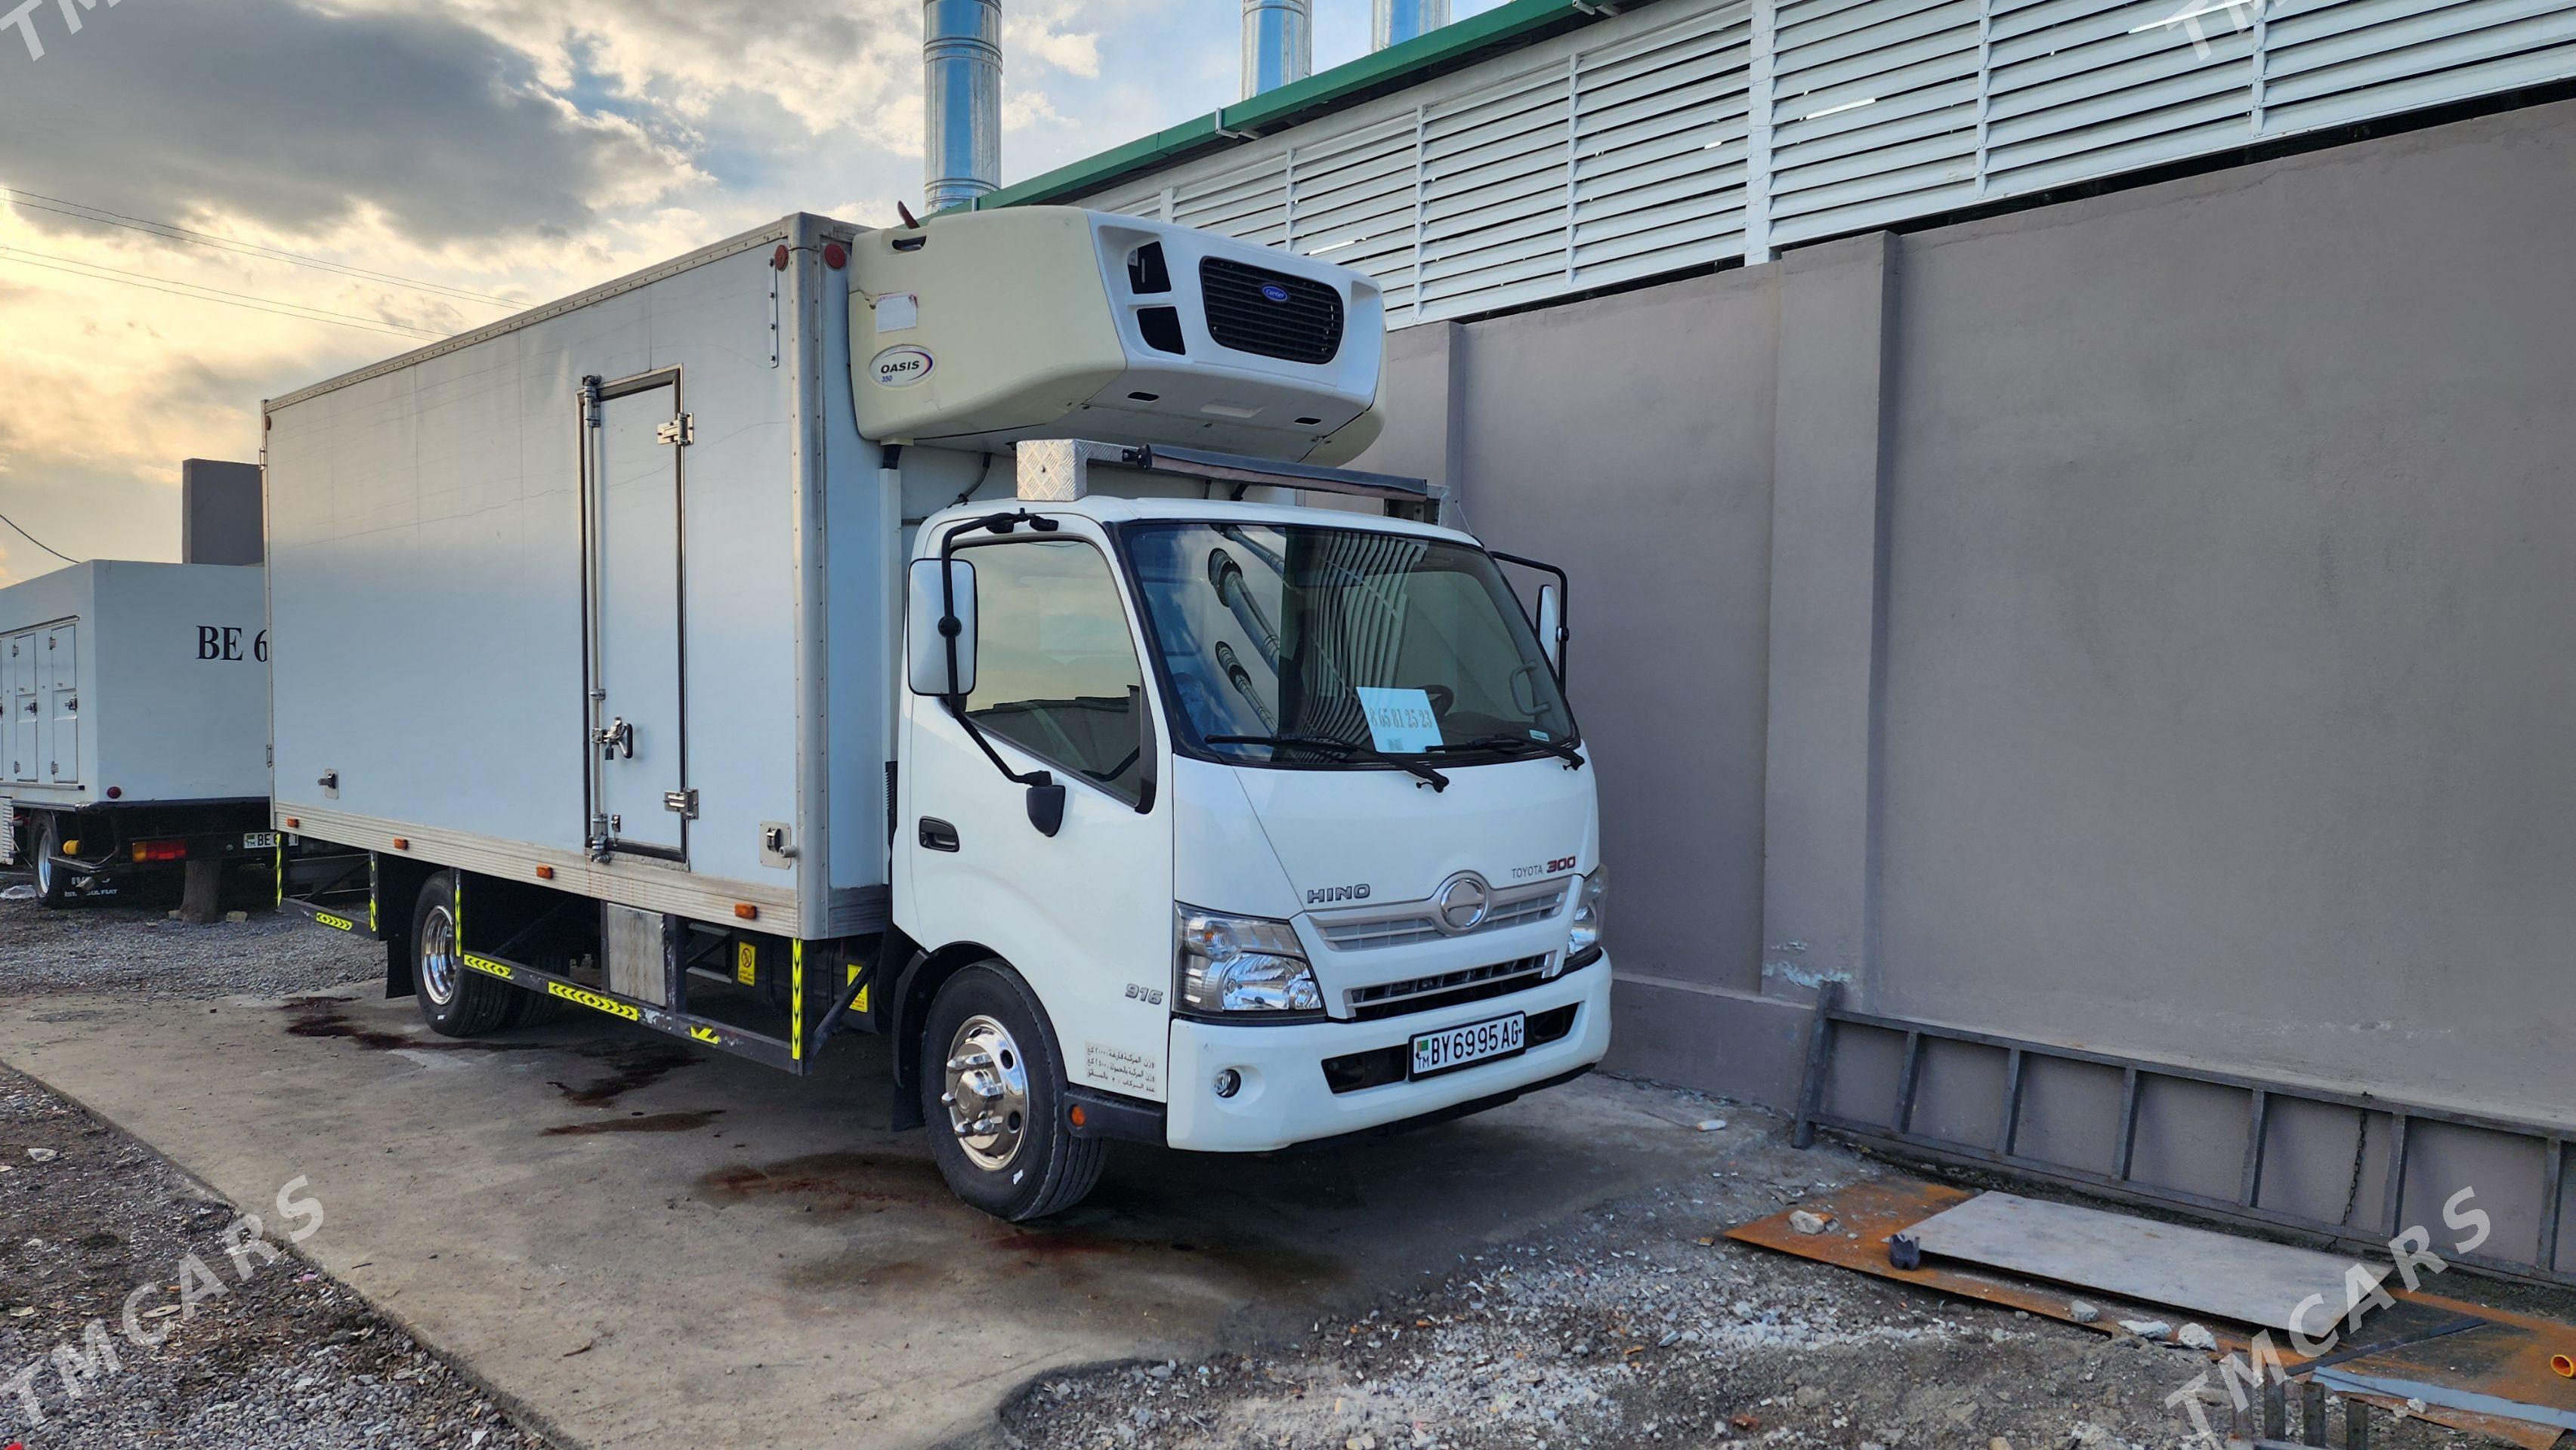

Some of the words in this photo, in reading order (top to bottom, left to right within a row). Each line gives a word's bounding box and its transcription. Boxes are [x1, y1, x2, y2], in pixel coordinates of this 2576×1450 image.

[881, 361, 919, 374] OASIS
[196, 625, 242, 661] BE
[254, 629, 267, 662] 6
[1369, 708, 1378, 727] 8
[1511, 865, 1543, 878] TOYOTA
[1546, 856, 1576, 873] 300
[1308, 884, 1370, 903] HINO
[1125, 983, 1163, 1004] 916
[1416, 1056, 1429, 1069] TM
